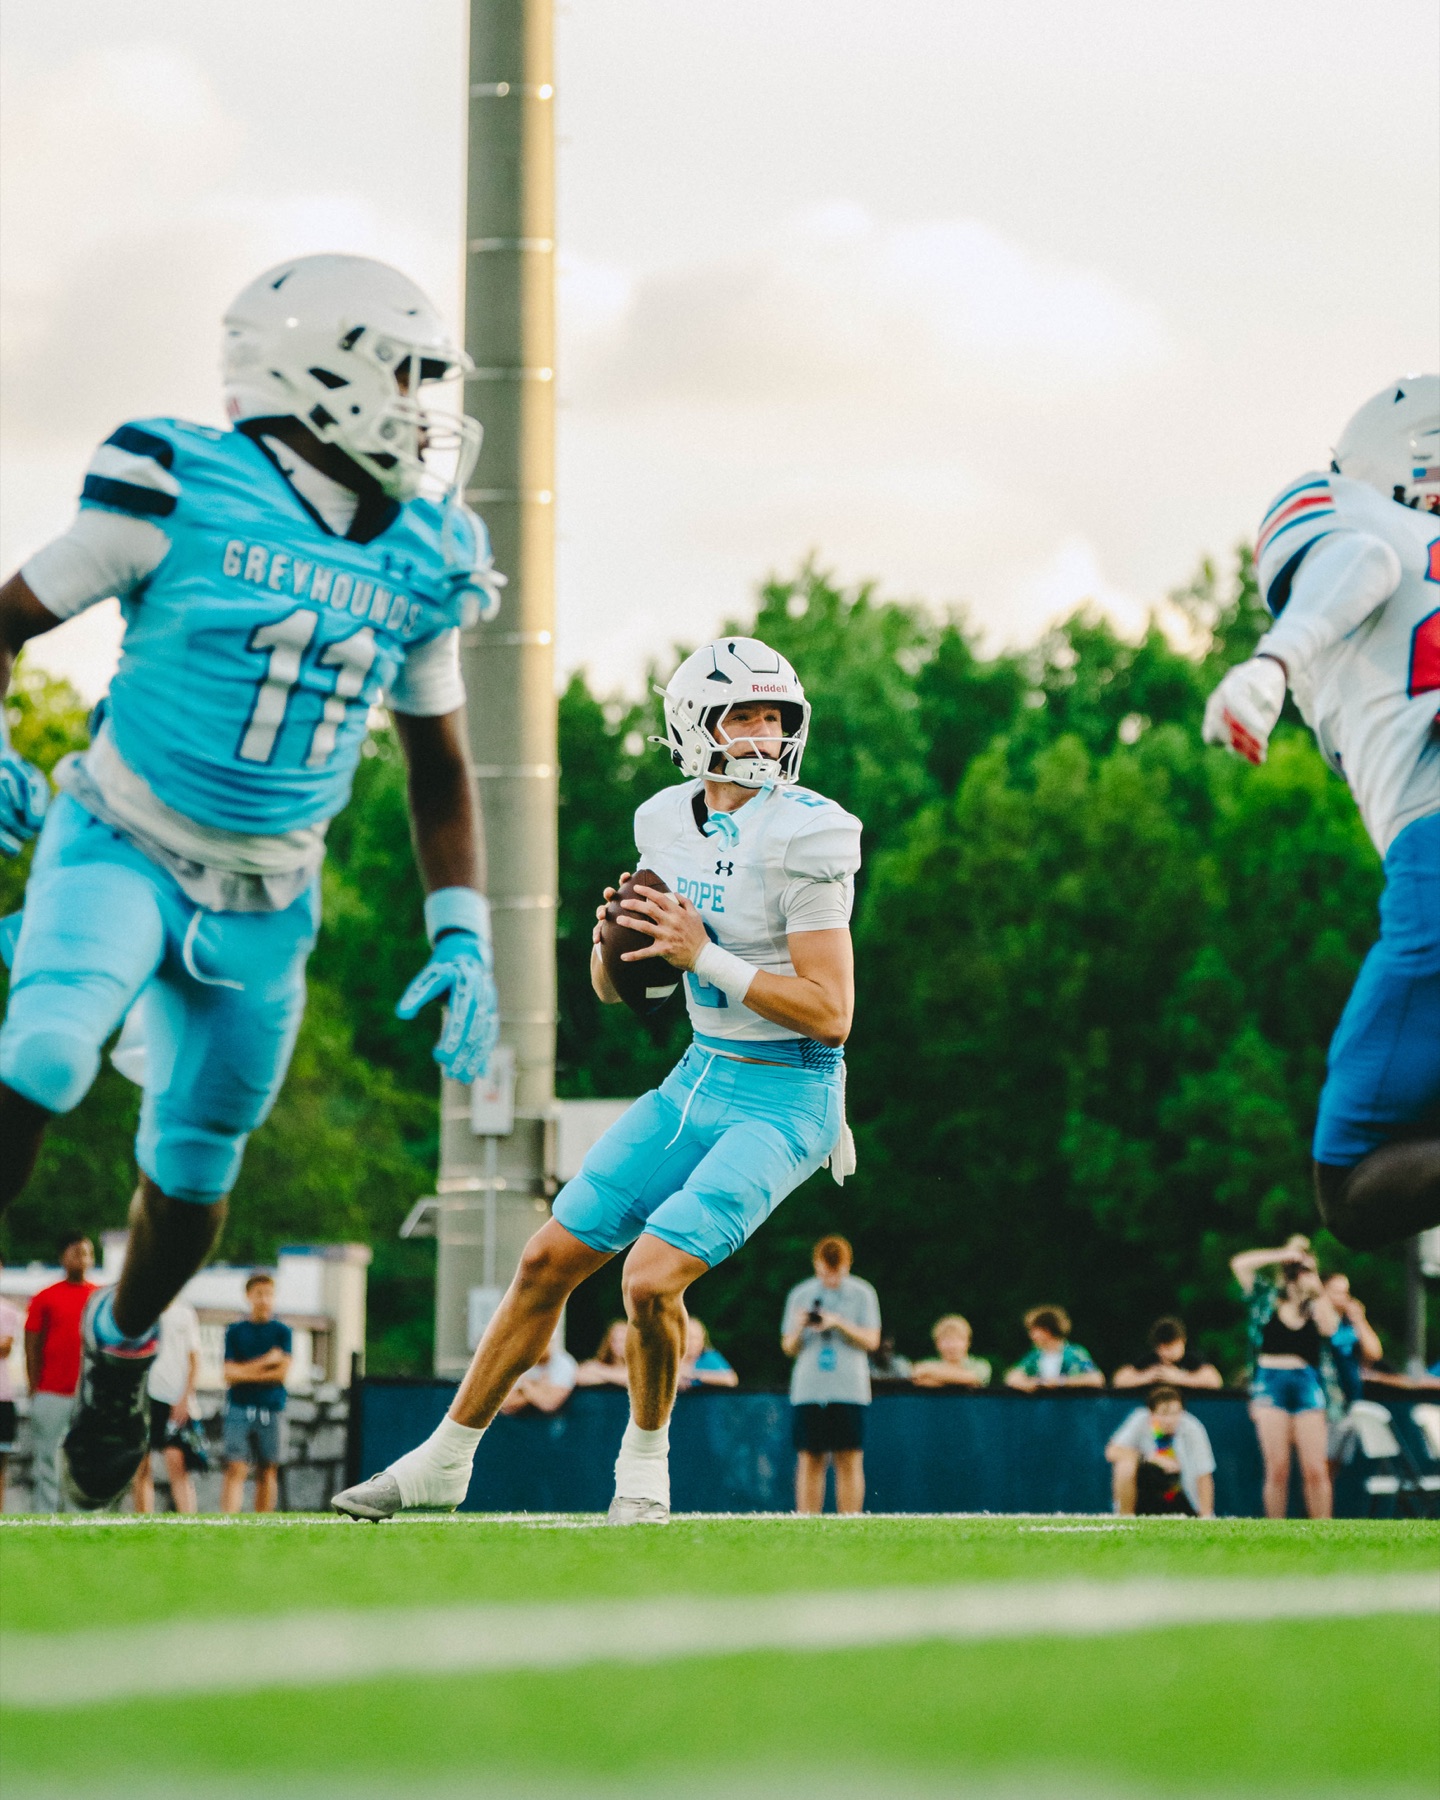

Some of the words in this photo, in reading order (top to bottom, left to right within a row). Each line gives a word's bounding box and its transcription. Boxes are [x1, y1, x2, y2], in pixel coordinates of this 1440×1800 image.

[223, 539, 422, 638] GREYHOUNDS
[235, 606, 378, 768] 11
[752, 684, 788, 693] Riddell
[677, 876, 725, 913] POPE
